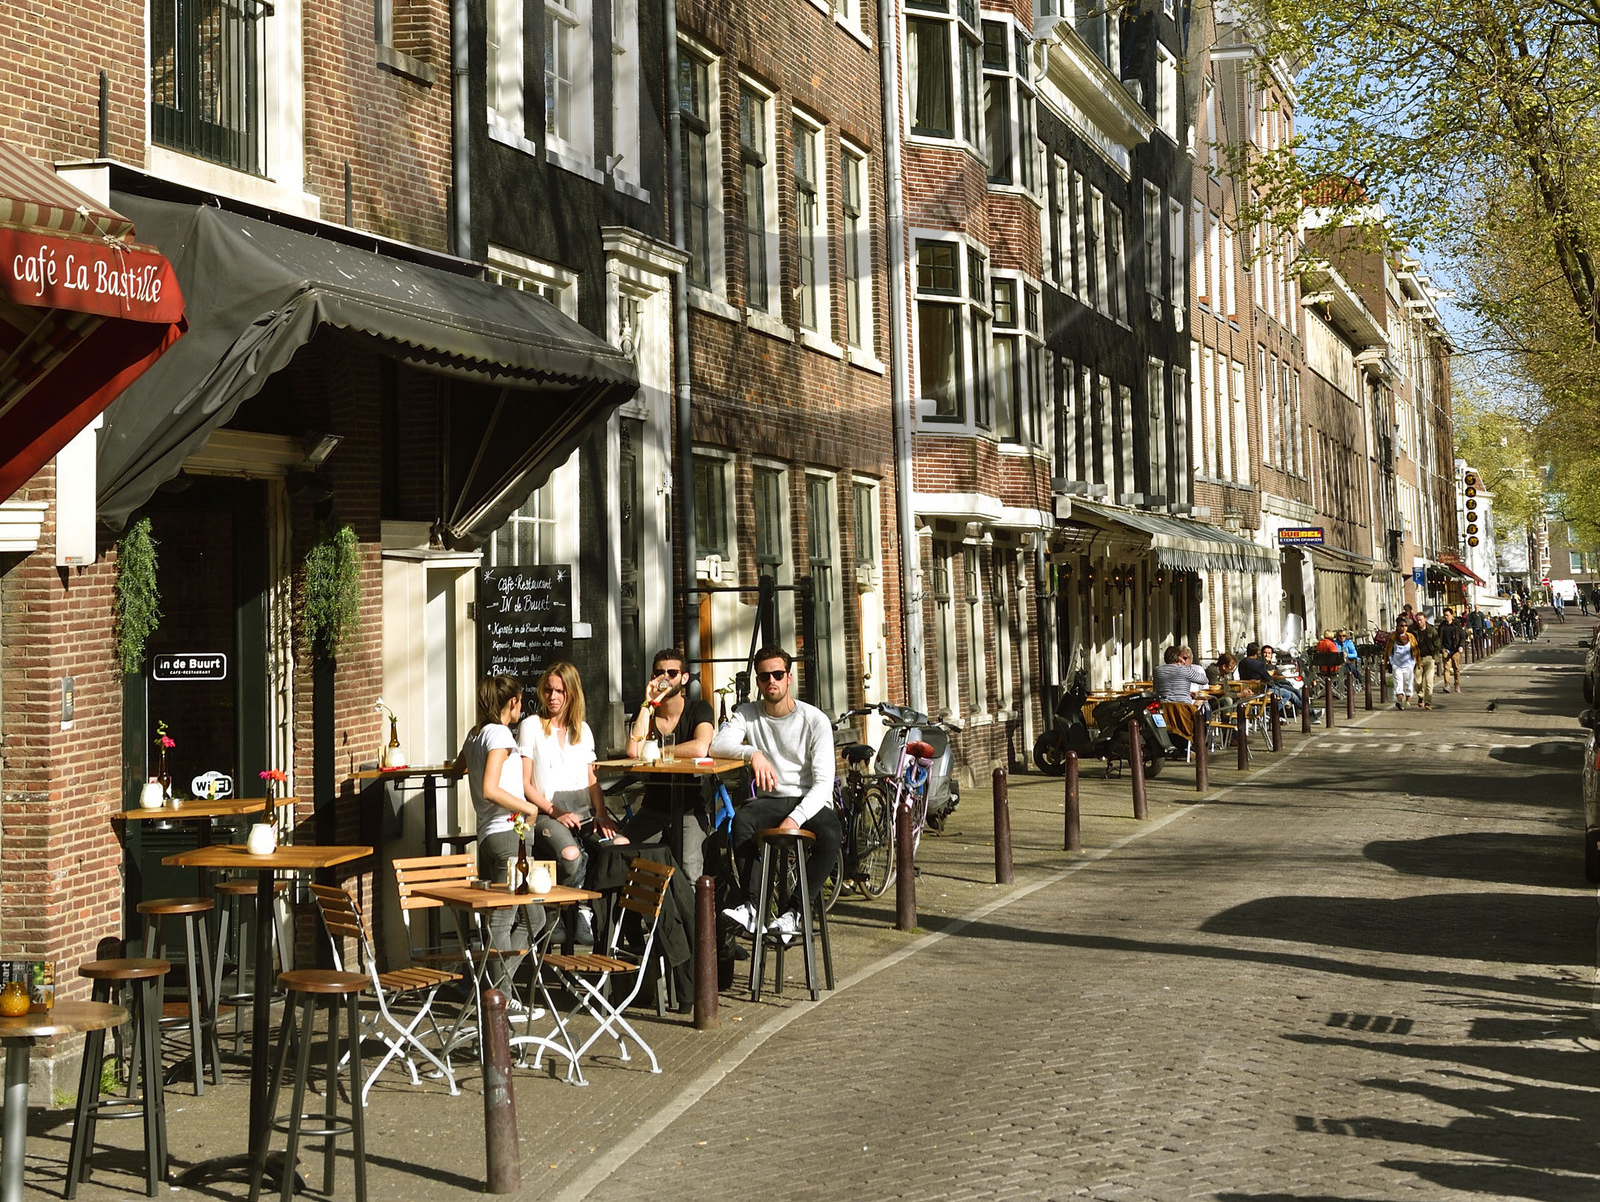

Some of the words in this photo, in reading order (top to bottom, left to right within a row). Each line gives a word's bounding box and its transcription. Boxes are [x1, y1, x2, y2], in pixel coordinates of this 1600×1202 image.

[13, 245, 58, 297] café
[63, 254, 90, 291] La
[94, 260, 162, 303] Bastille
[1415, 572, 1421, 581] P
[160, 659, 170, 669] in
[173, 659, 186, 669] de
[189, 658, 221, 669] Buurt
